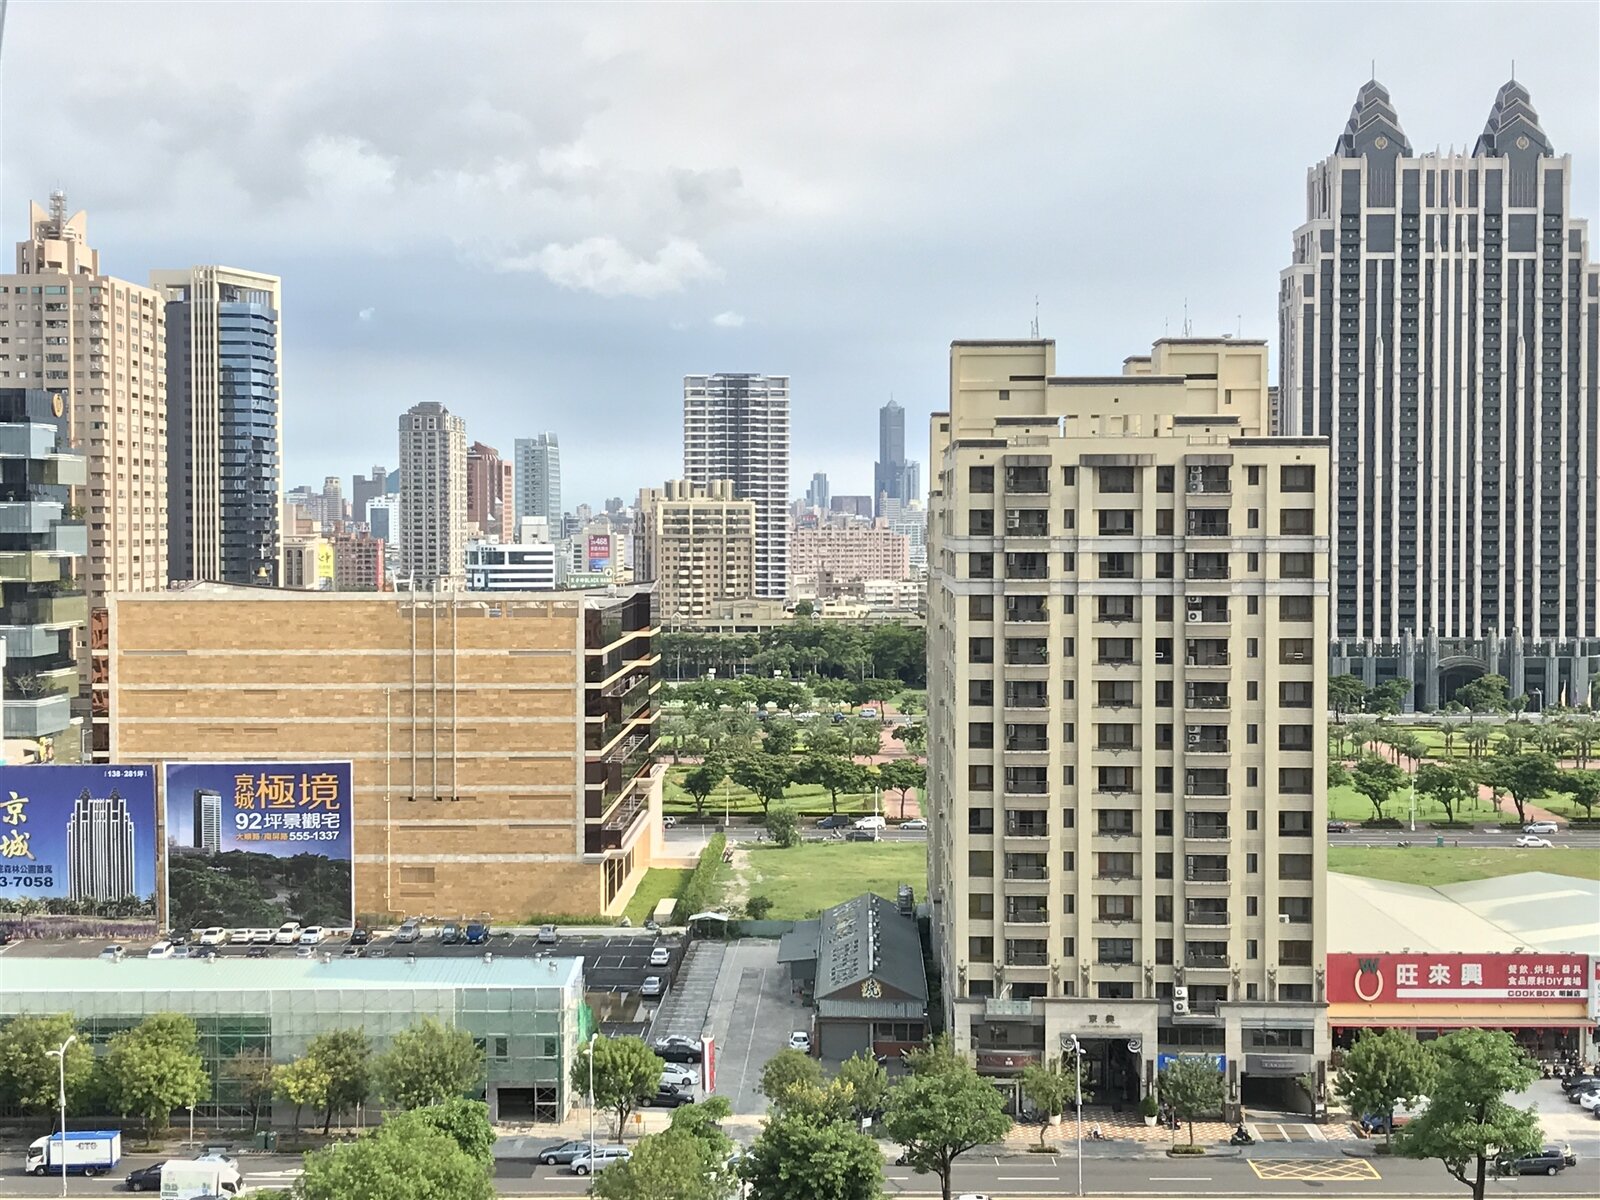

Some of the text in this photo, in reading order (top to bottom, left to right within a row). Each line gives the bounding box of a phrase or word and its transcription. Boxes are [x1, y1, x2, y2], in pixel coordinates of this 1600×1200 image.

[234, 772, 340, 810] 京城 極境
[235, 812, 340, 830] 92坪景觀宅
[289, 831, 340, 841] 555-1337
[1396, 963, 1483, 986] 旺來興
[1508, 976, 1582, 986] 食品原料DIY廣場
